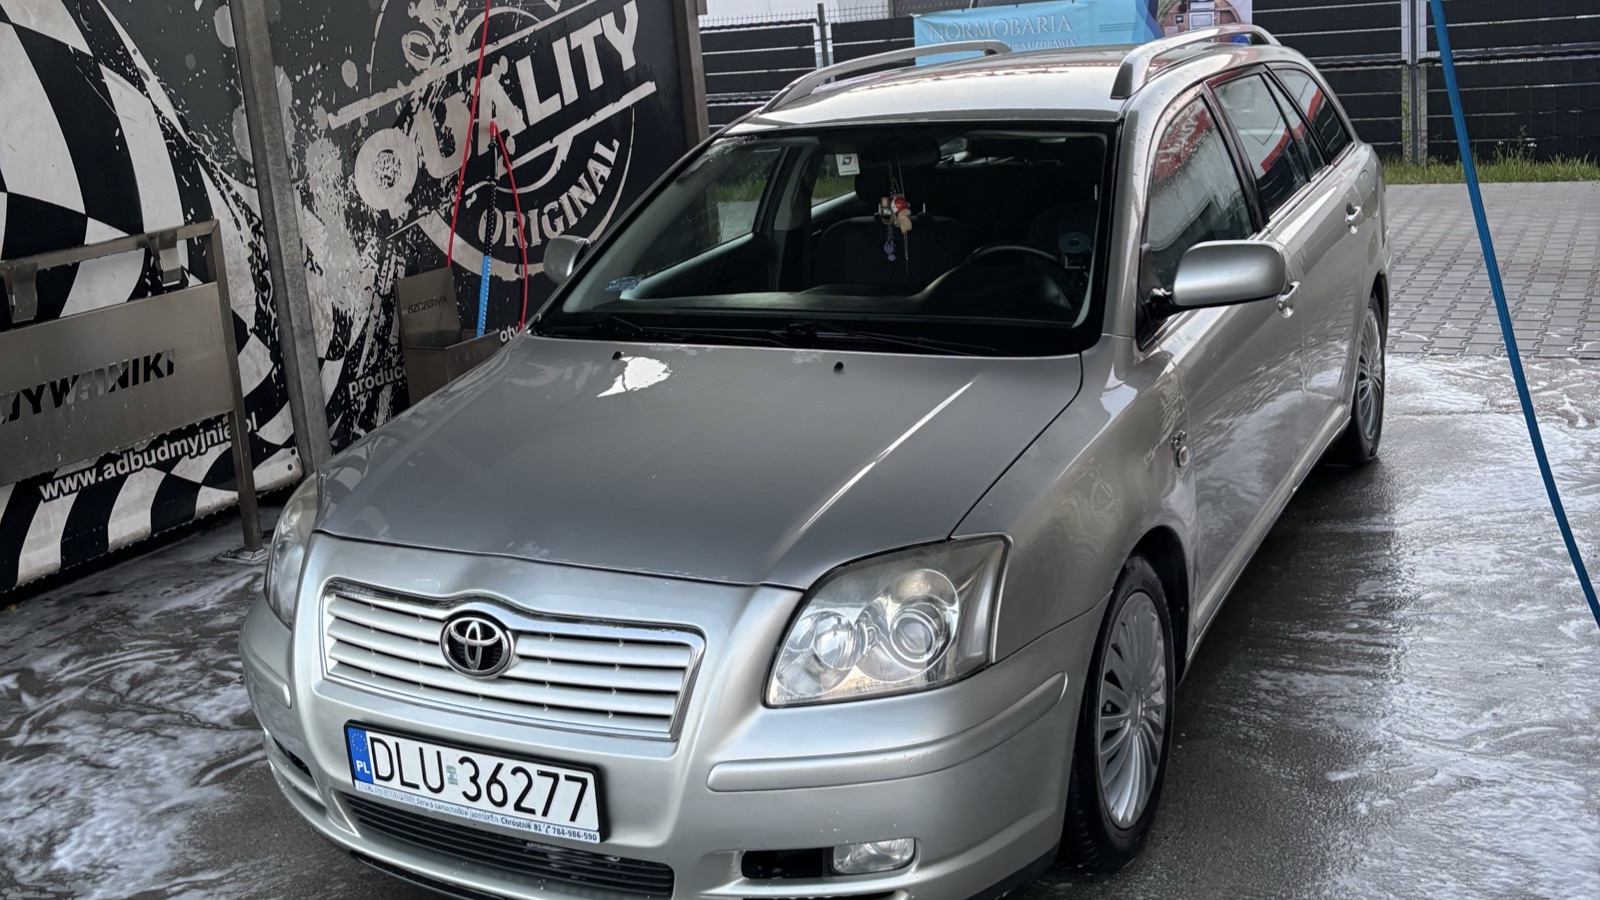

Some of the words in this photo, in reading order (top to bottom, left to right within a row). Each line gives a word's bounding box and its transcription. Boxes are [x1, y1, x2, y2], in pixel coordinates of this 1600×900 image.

[929, 14, 1073, 42] NORMOBARIA
[354, 0, 639, 220] QUALITY
[478, 138, 620, 248] ORIGINAL
[39, 411, 258, 501] www.adbudmyjniel
[356, 760, 370, 774] PL
[369, 736, 445, 794] DLU
[458, 755, 589, 822] 36277
[552, 826, 598, 842] 784-986-590
